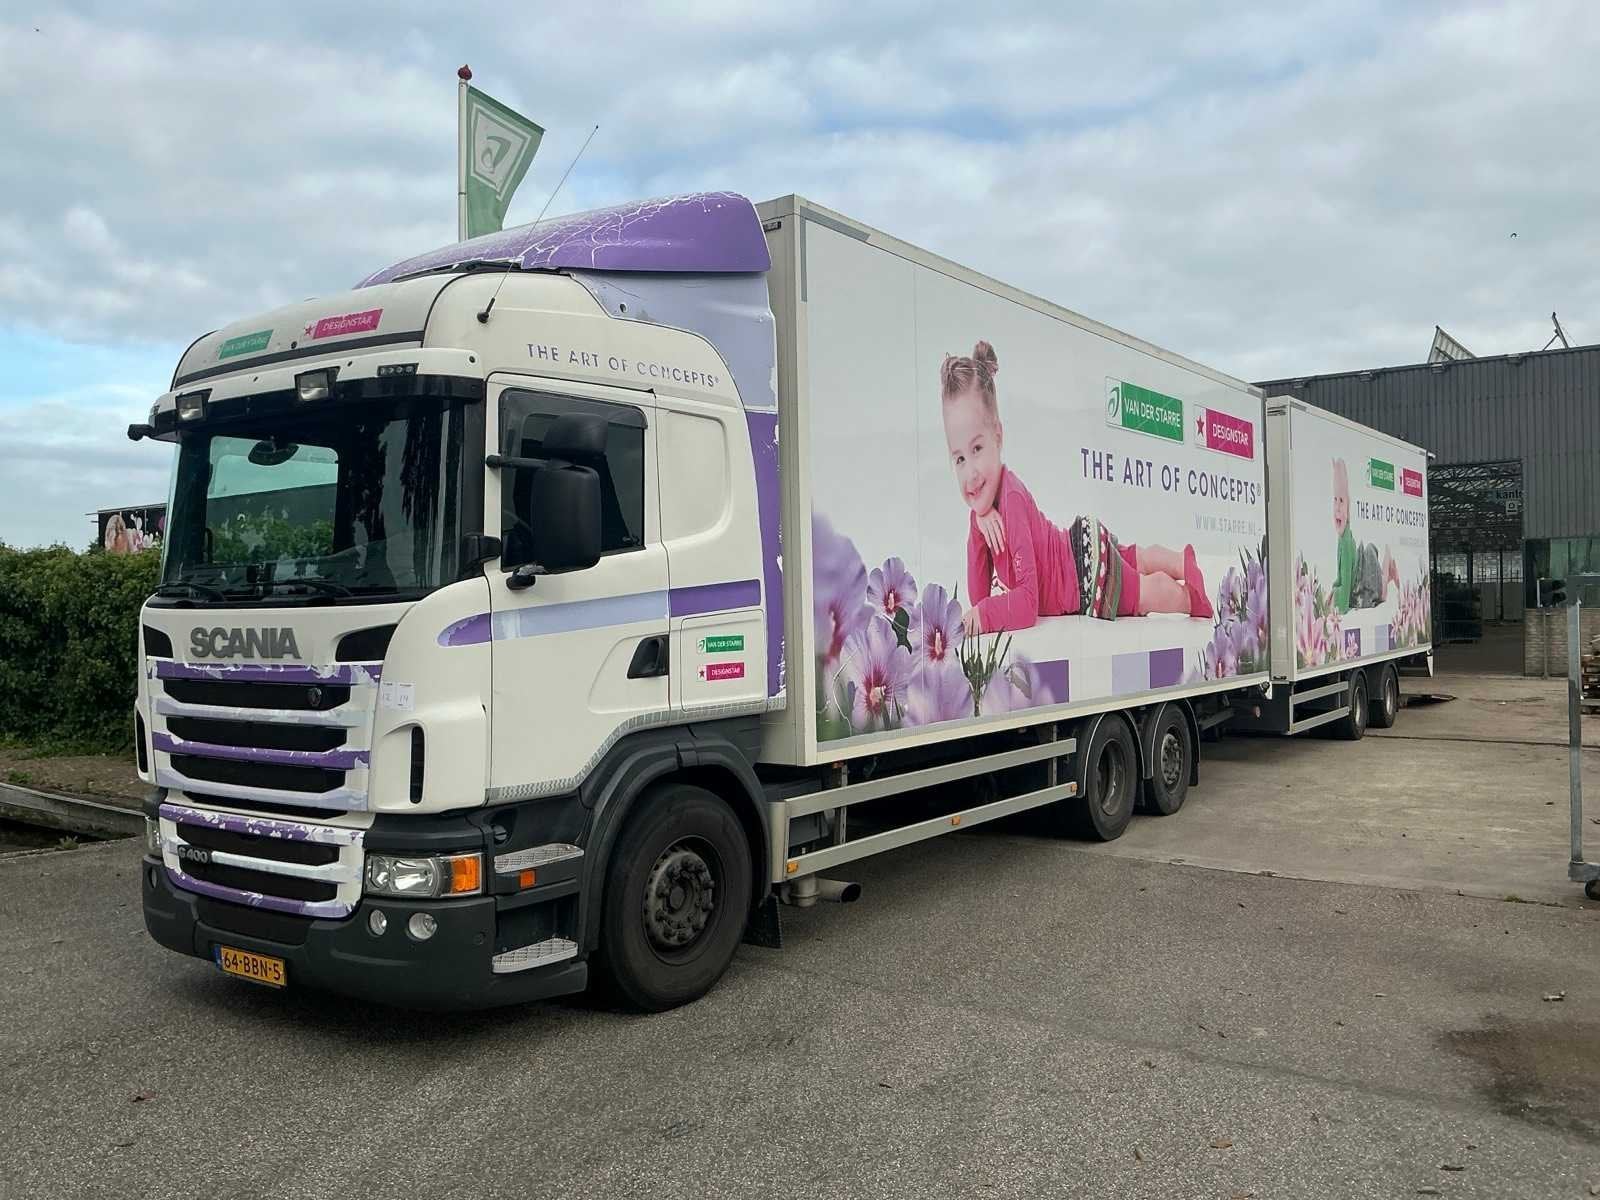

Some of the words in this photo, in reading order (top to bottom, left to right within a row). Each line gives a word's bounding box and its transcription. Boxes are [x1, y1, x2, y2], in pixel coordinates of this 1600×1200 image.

[527, 343, 559, 362] THE
[569, 350, 600, 368] ART
[608, 356, 629, 372] OF
[1124, 398, 1140, 417] VAN
[1141, 404, 1155, 420] DER
[1155, 407, 1181, 428] STARRE
[1212, 423, 1249, 446] DESIGNSTAR
[1081, 448, 1114, 482] THE
[1123, 457, 1152, 488] ART
[1161, 464, 1180, 492] OF
[1356, 500, 1369, 520] THE
[1372, 504, 1383, 521] ART
[1385, 506, 1394, 523] OF
[190, 626, 302, 660] SCANIA
[223, 951, 281, 981] 64-BBN-5
